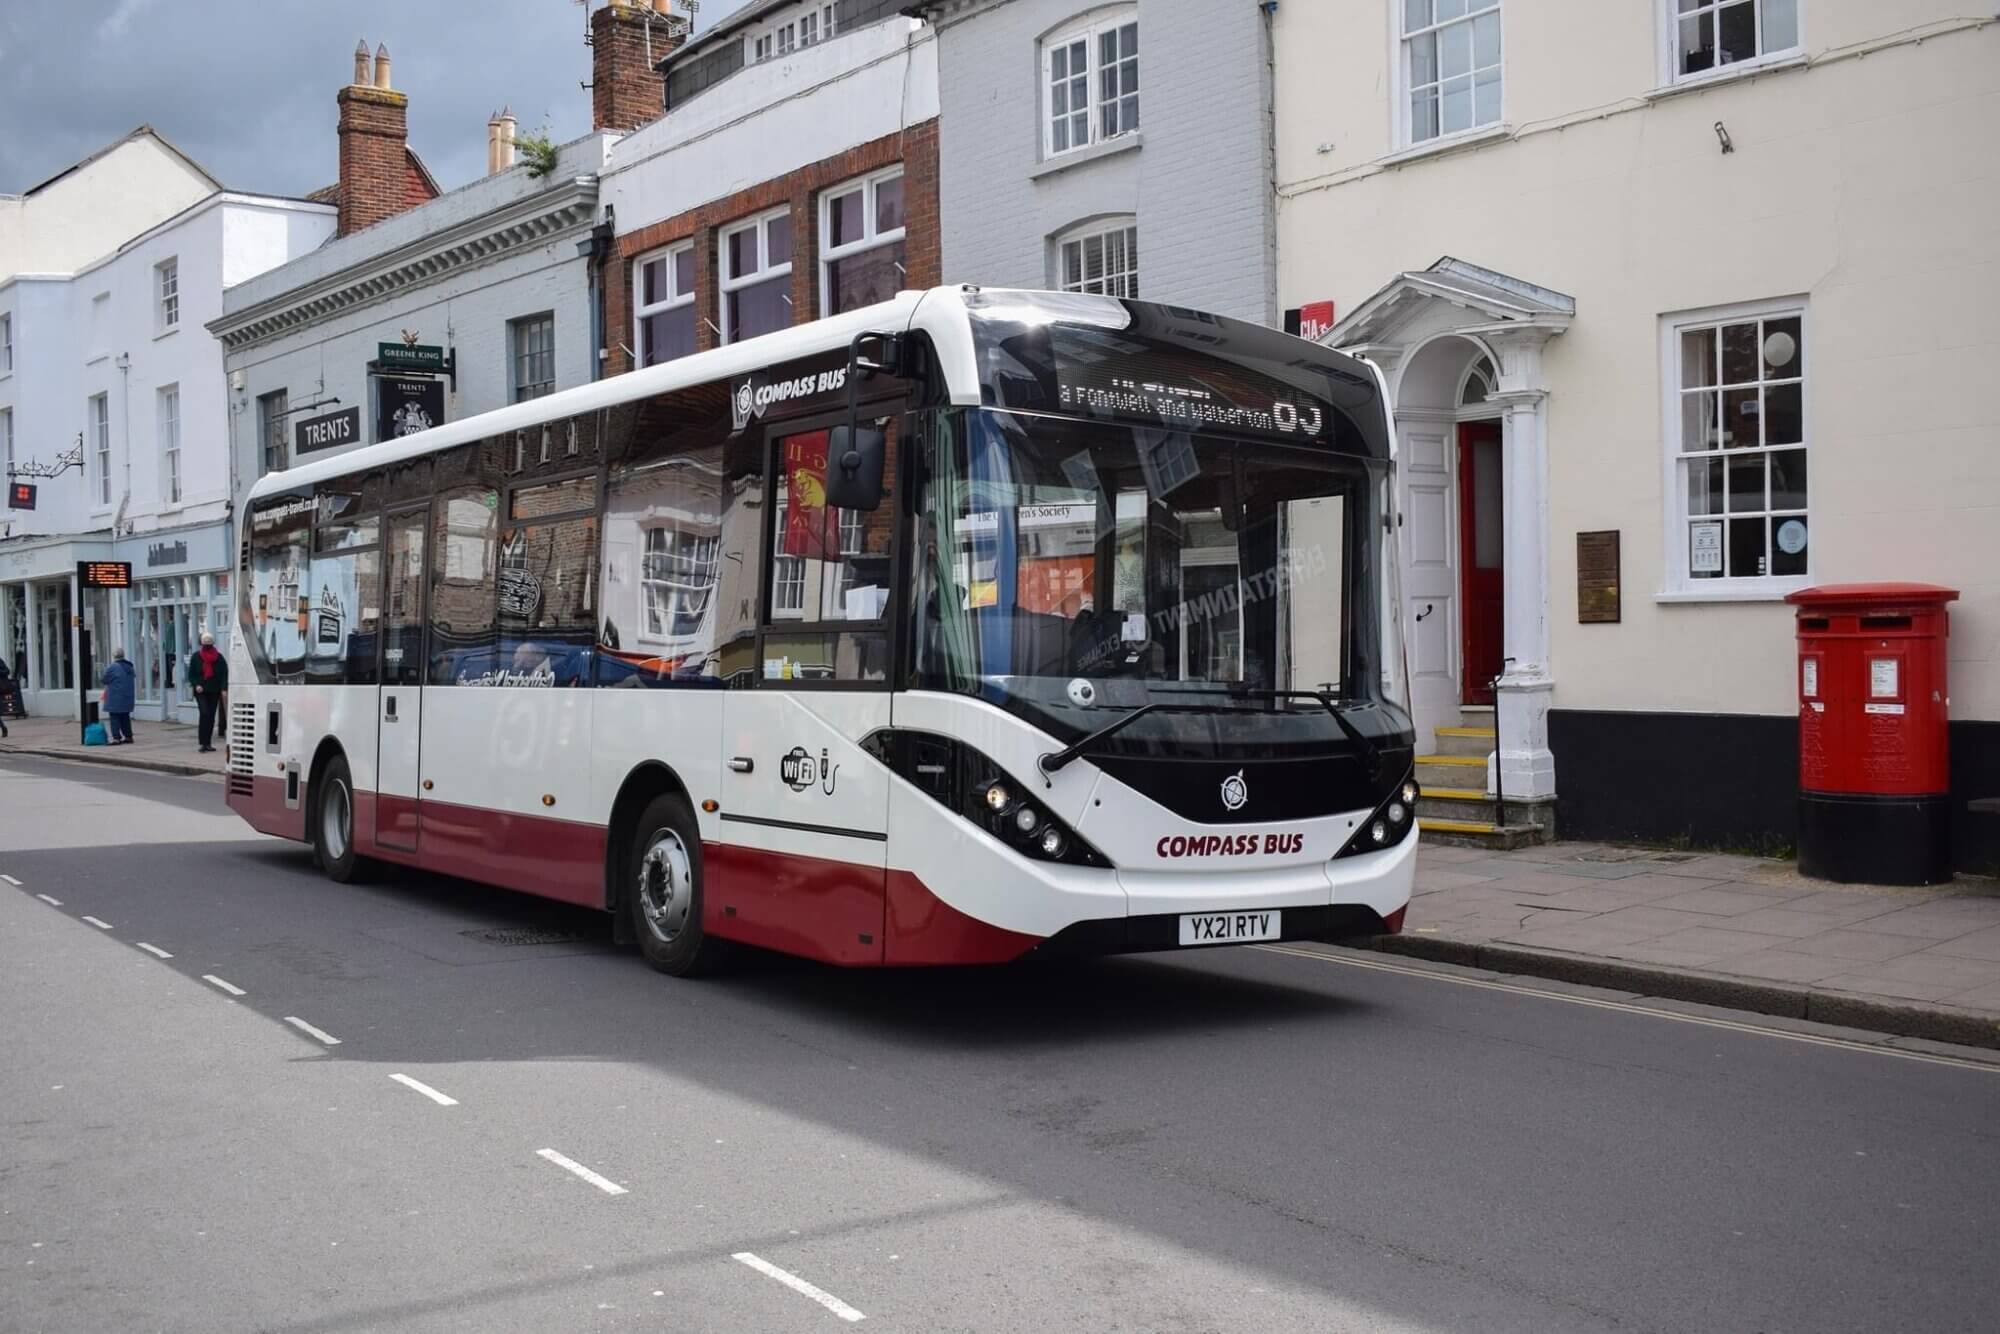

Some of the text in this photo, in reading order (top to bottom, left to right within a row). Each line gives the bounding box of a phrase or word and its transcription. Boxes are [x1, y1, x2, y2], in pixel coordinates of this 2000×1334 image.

[384, 349, 440, 360] GREENE KING
[397, 383, 427, 392] TRENTS
[755, 368, 846, 405] COMPASS BUS
[1156, 398, 1187, 418] and
[305, 416, 350, 446] TRENTS
[1038, 505, 1072, 519] Society
[1156, 833, 1304, 858] COMPASS BUS
[1191, 914, 1270, 940] YX21 RTV
